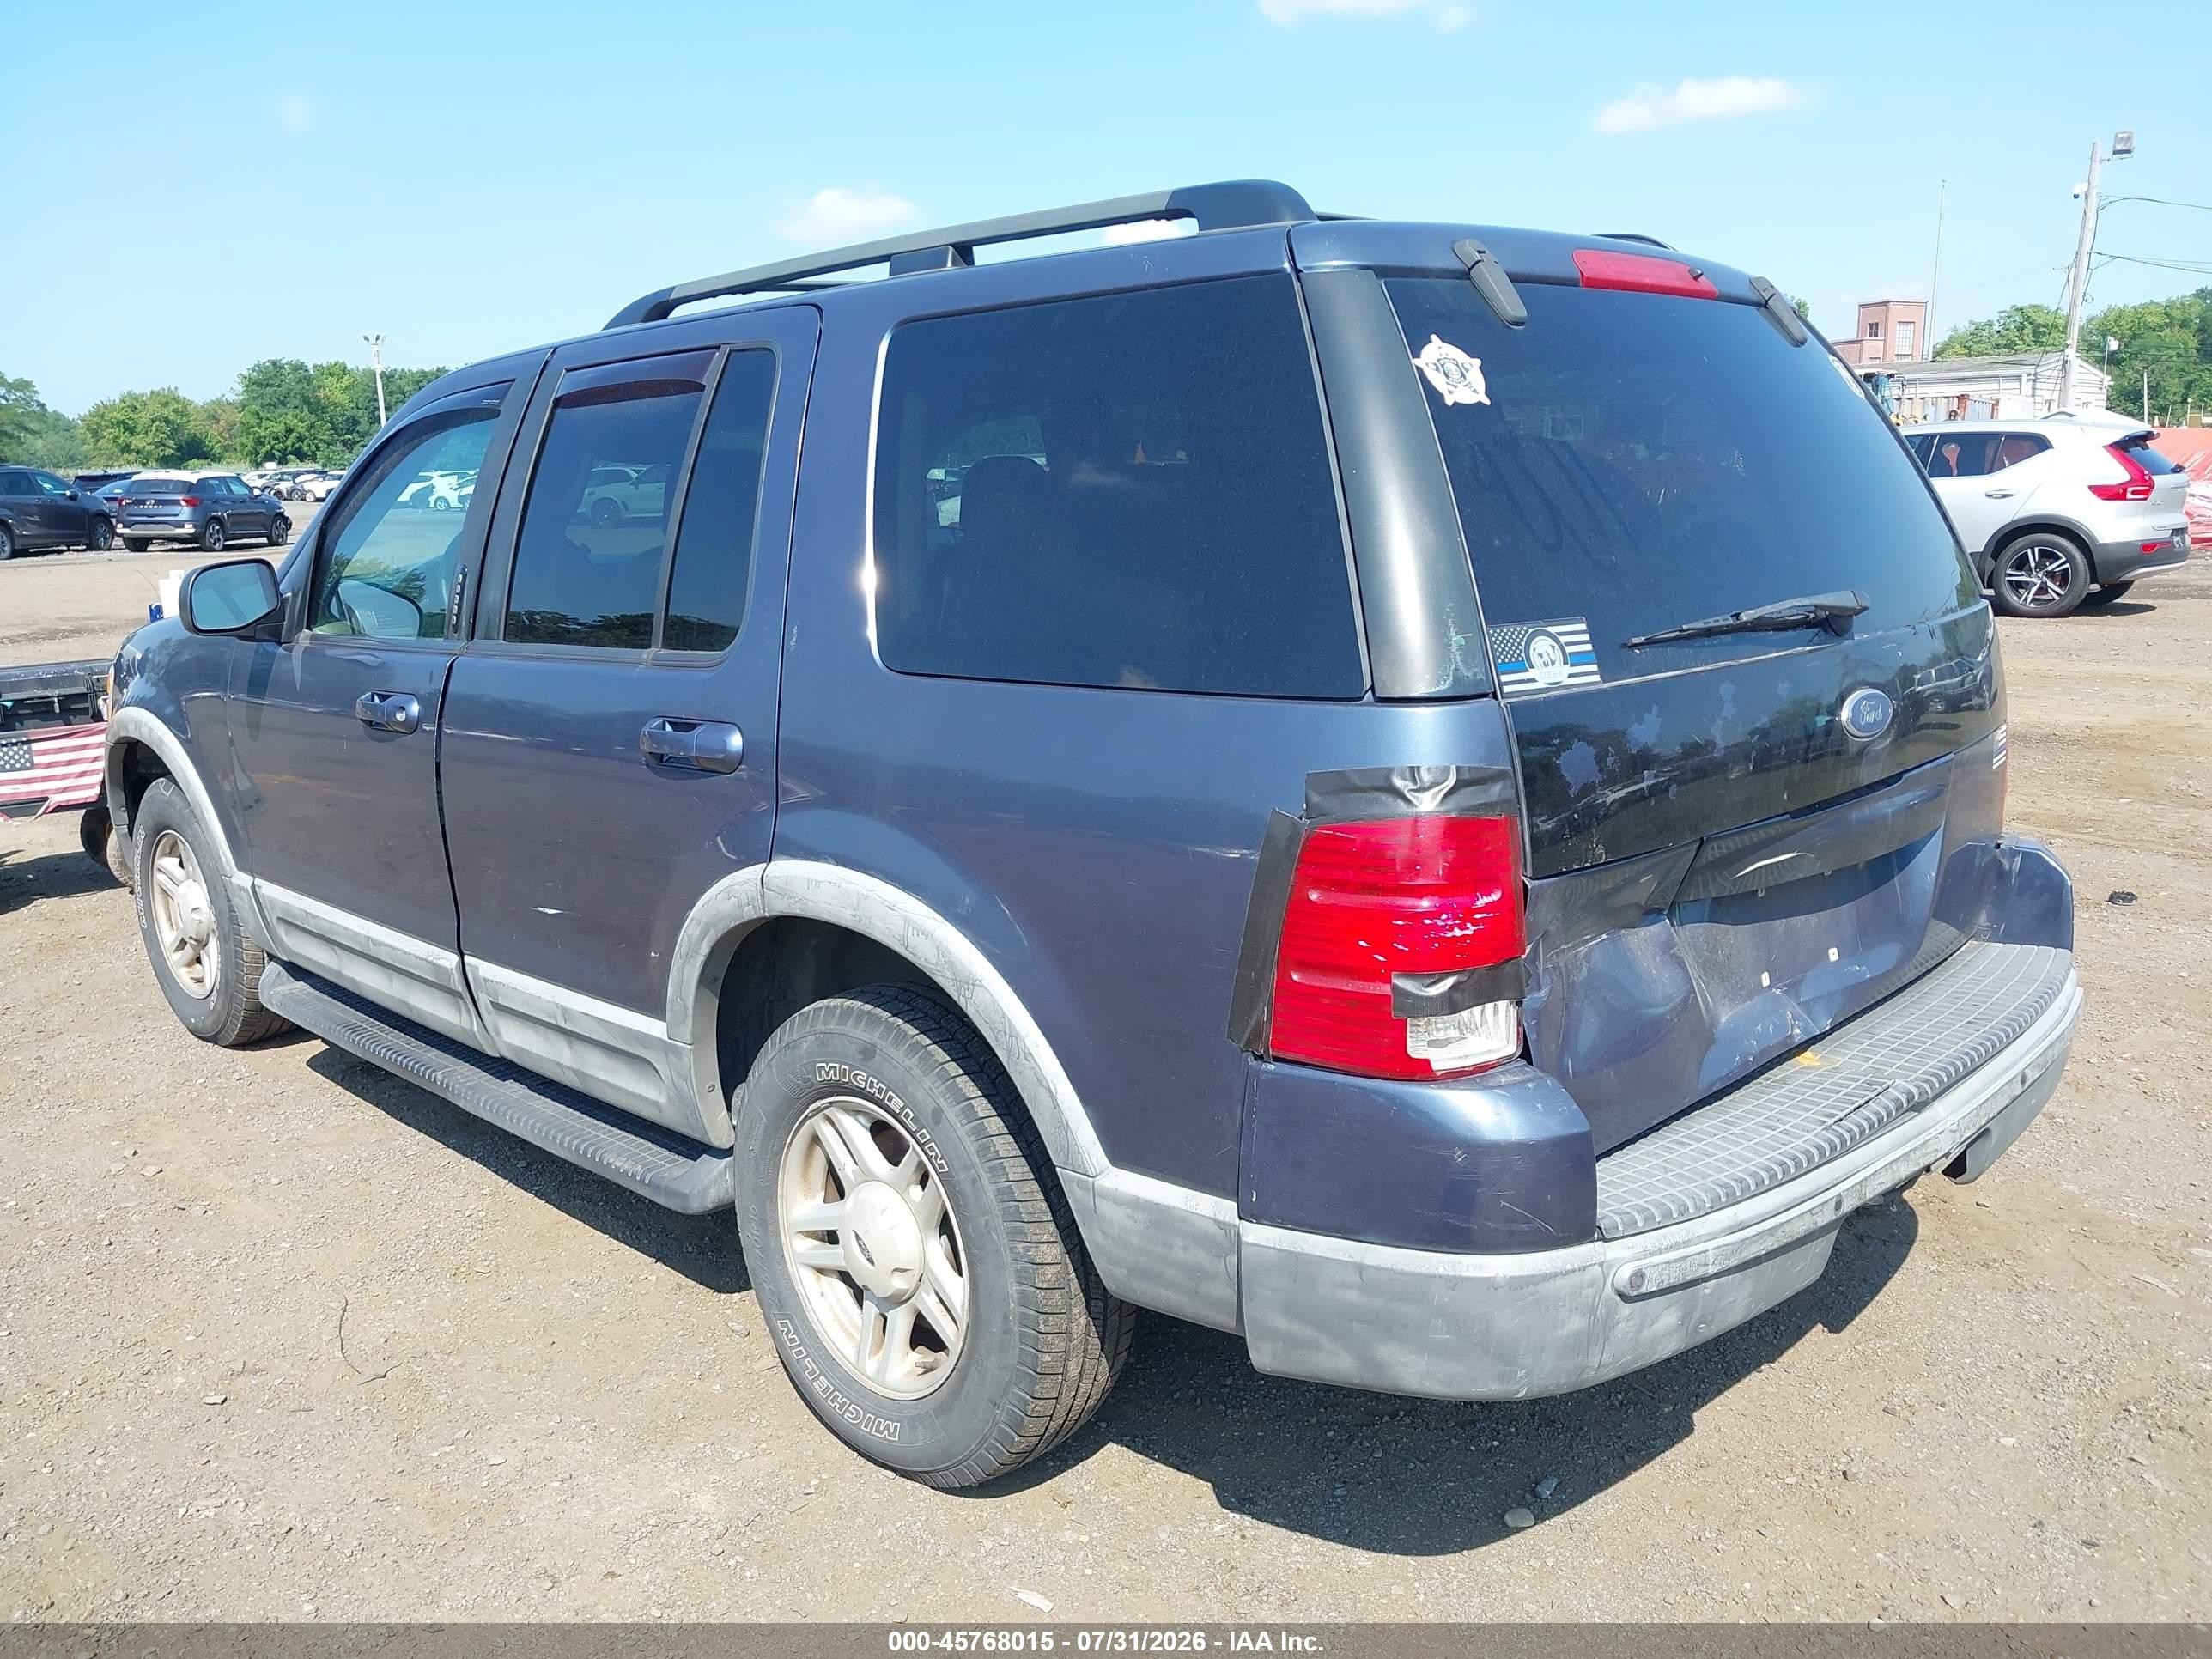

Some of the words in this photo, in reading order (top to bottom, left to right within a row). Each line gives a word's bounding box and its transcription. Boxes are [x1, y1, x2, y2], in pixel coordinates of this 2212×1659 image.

[1859, 699, 1883, 726] Ford
[815, 1062, 949, 1174] MICHELIN
[776, 1319, 900, 1441] MICHELIN
